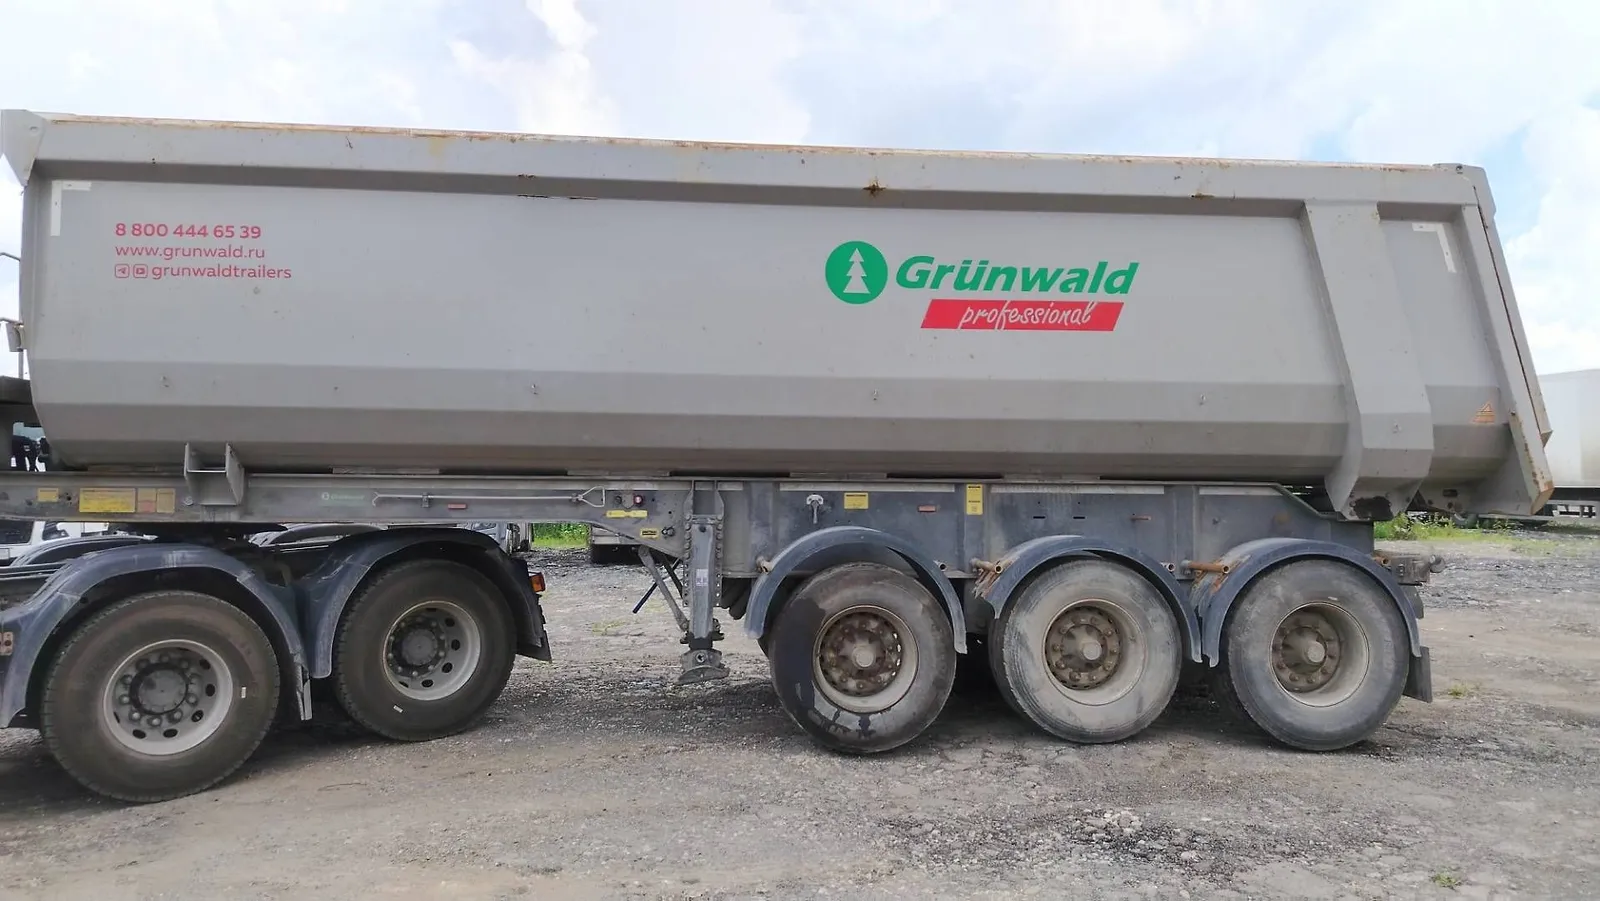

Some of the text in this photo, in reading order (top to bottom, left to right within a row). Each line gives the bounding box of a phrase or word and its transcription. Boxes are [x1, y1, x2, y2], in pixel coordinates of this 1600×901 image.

[115, 223, 261, 239] 8 800 444 65 39
[115, 244, 265, 260] www.grunwald.ru
[151, 264, 292, 280] grunwaldtrailers
[895, 255, 1140, 295] Grünwald
[958, 300, 1098, 331] professional
